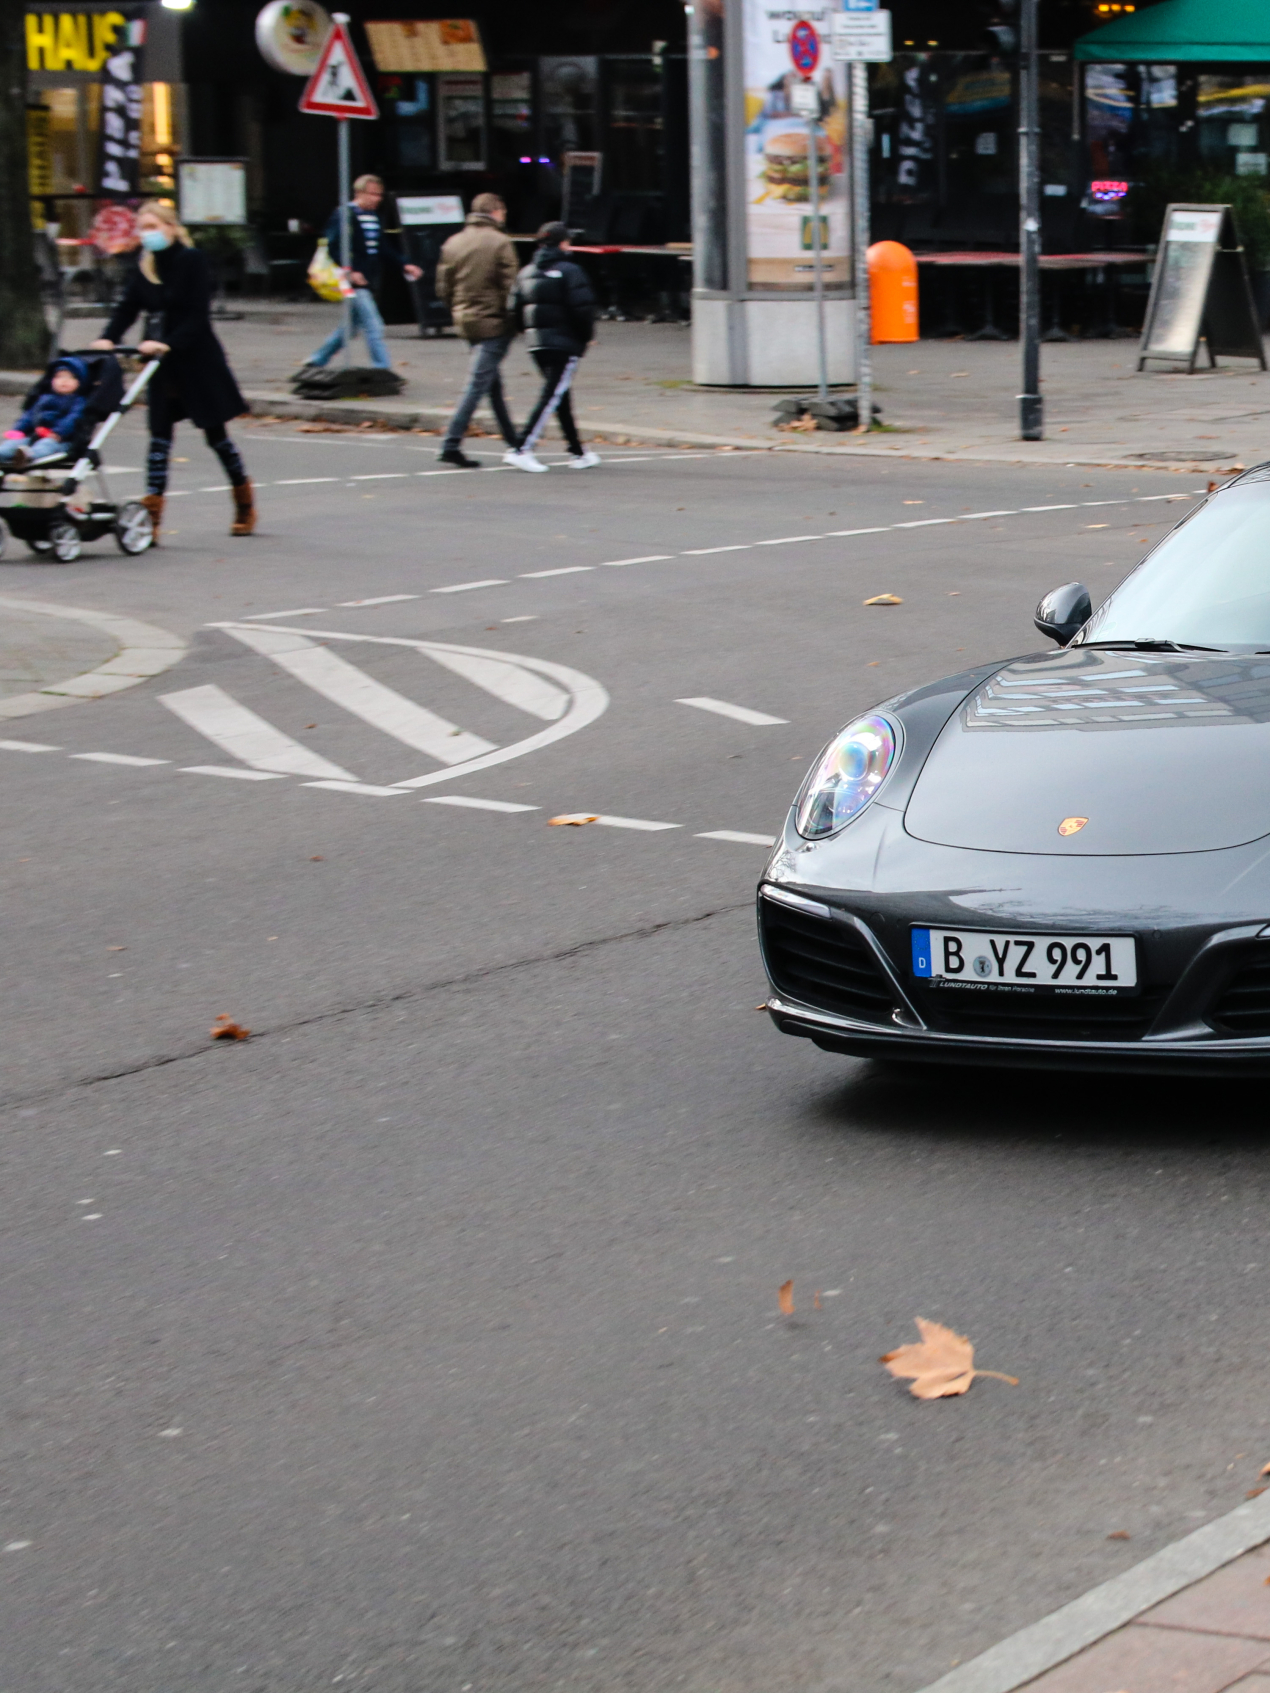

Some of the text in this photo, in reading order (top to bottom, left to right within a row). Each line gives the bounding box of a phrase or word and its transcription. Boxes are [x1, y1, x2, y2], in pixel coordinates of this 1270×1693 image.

[918, 957, 926, 968] D
[943, 935, 1118, 981] B YZ 991
[939, 981, 988, 990] LUNDTAUTO
[1054, 987, 1118, 996] www.lundtauto.de
